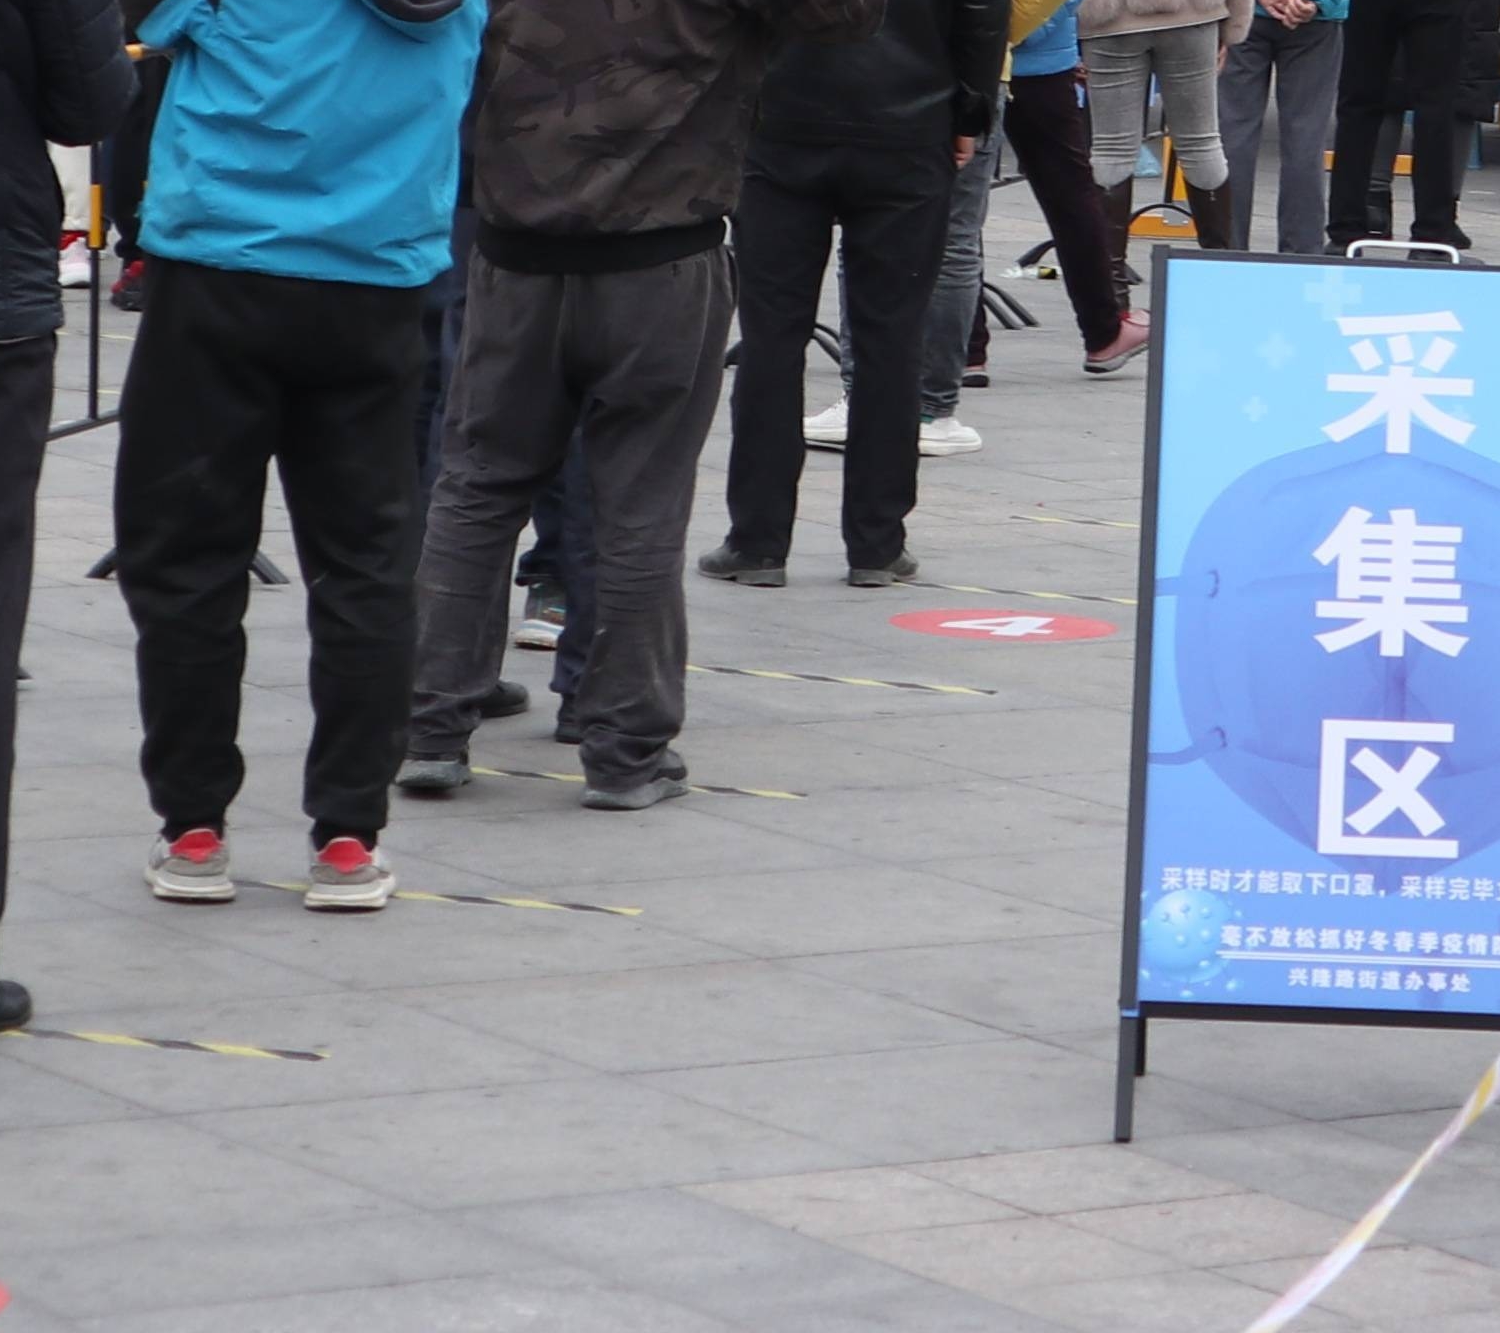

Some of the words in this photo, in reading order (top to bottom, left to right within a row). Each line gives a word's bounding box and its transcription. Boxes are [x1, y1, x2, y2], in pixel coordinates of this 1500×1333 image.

[940, 615, 1055, 637] 4
[1312, 311, 1477, 858] 采集区
